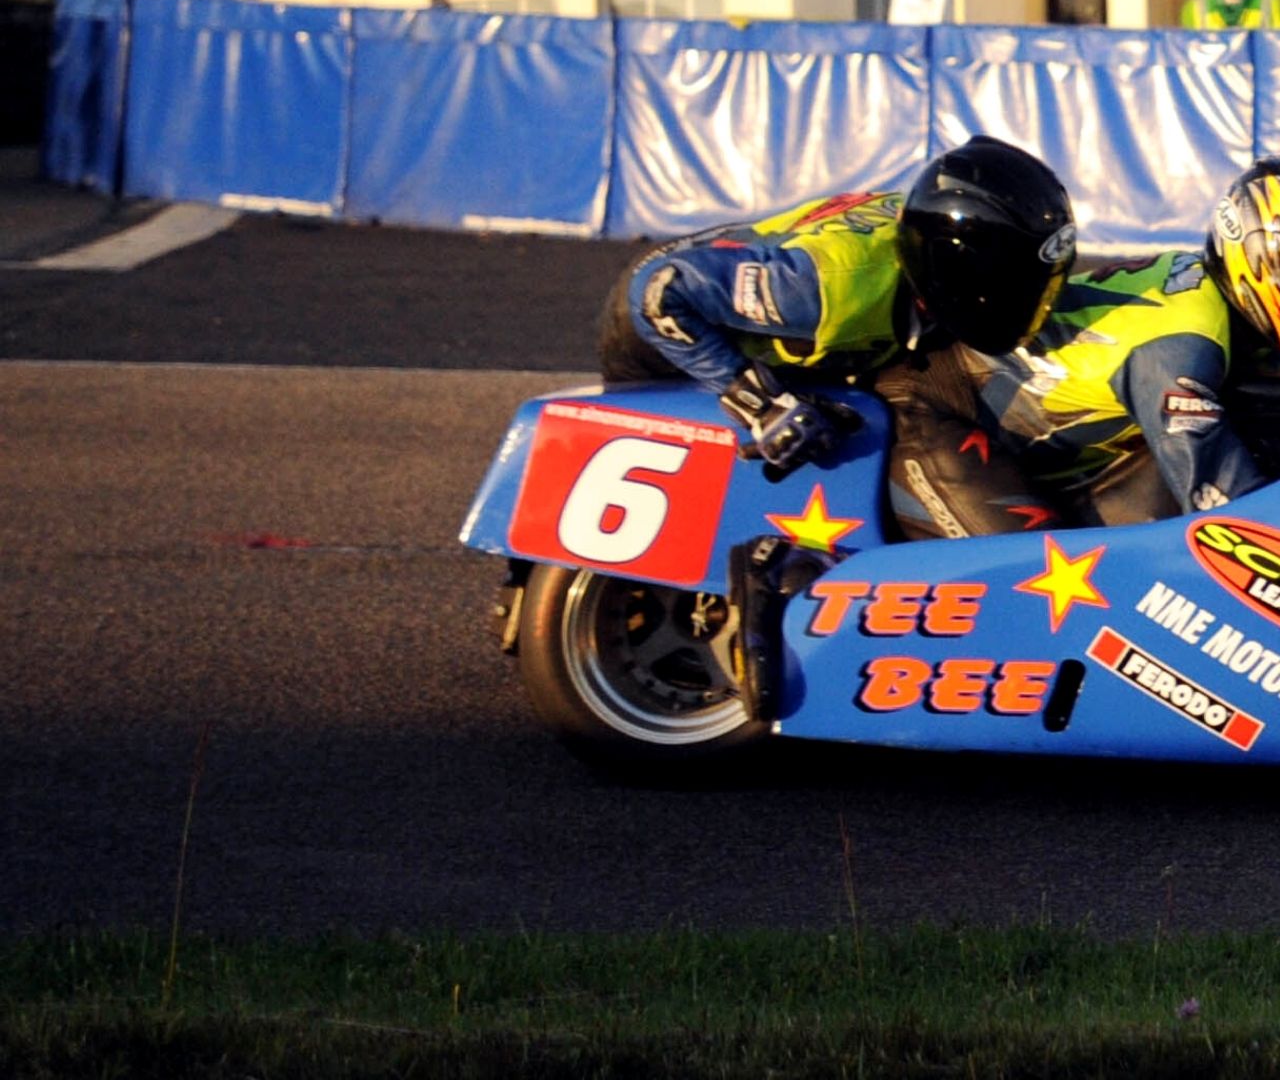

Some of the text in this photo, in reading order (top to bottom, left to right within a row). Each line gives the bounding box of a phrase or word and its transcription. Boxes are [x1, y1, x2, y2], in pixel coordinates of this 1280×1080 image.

[556, 434, 692, 565] 6
[805, 580, 988, 637] TEE
[1134, 580, 1216, 646] NME
[855, 655, 1057, 715] BEE
[1124, 652, 1229, 727] FERODO
